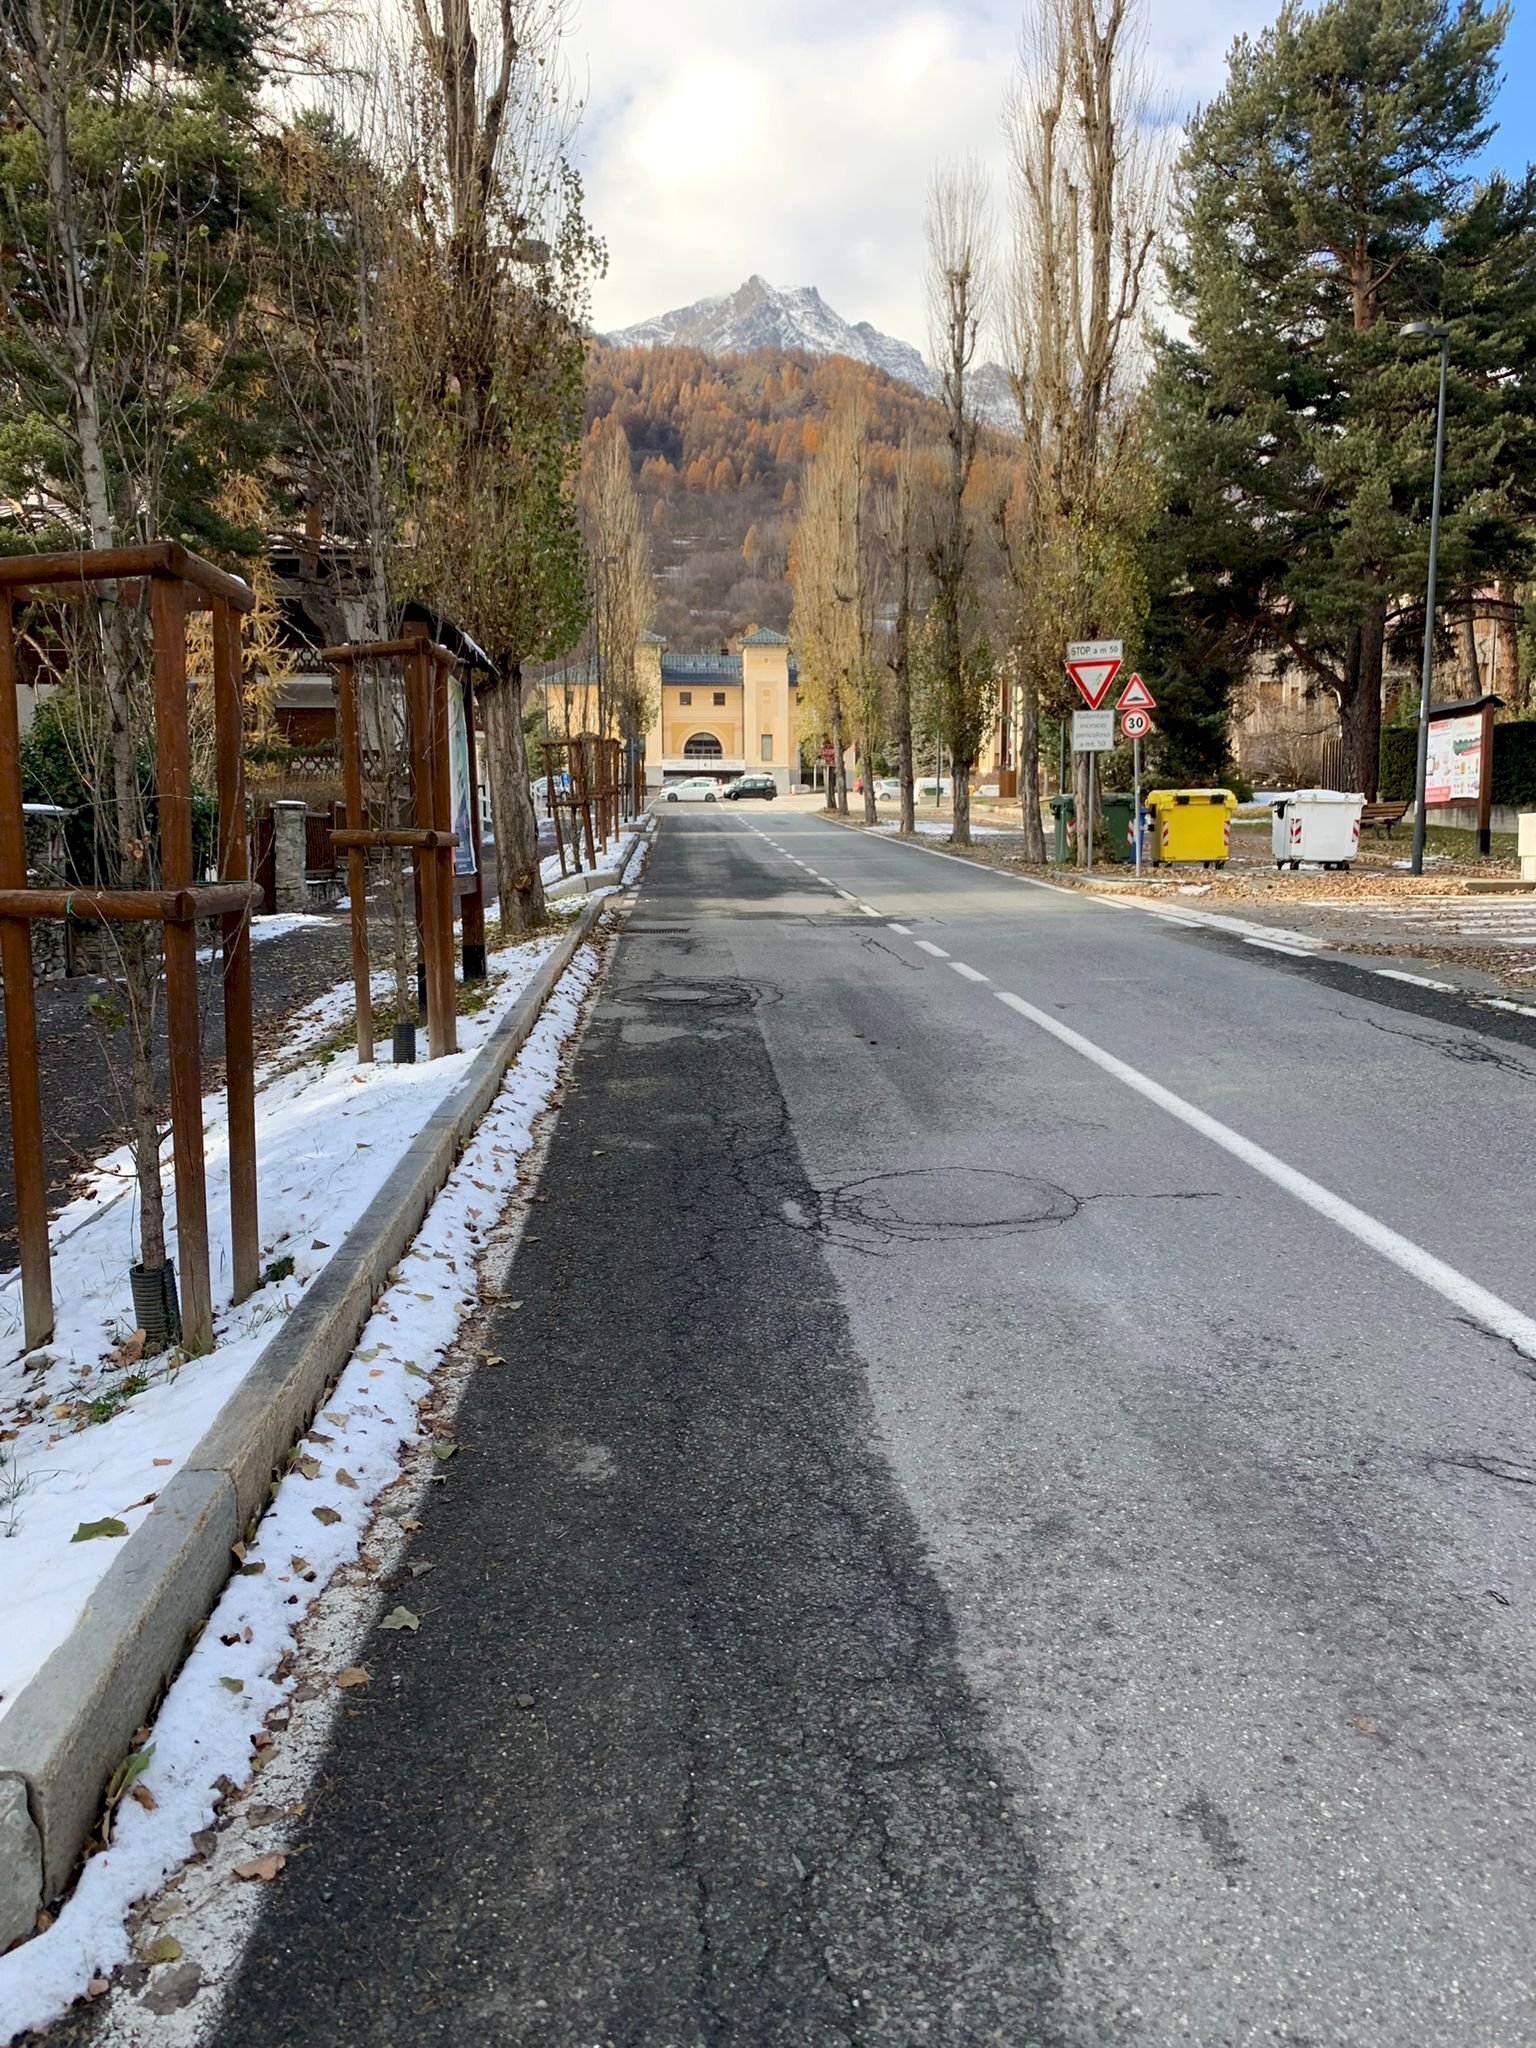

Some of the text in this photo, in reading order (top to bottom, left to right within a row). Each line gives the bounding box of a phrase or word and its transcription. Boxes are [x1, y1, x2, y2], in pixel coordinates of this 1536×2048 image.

[1071, 646, 1090, 656] STOP
[1109, 645, 1118, 653] 50
[1128, 717, 1144, 729] 30
[1097, 740, 1106, 748] 50
